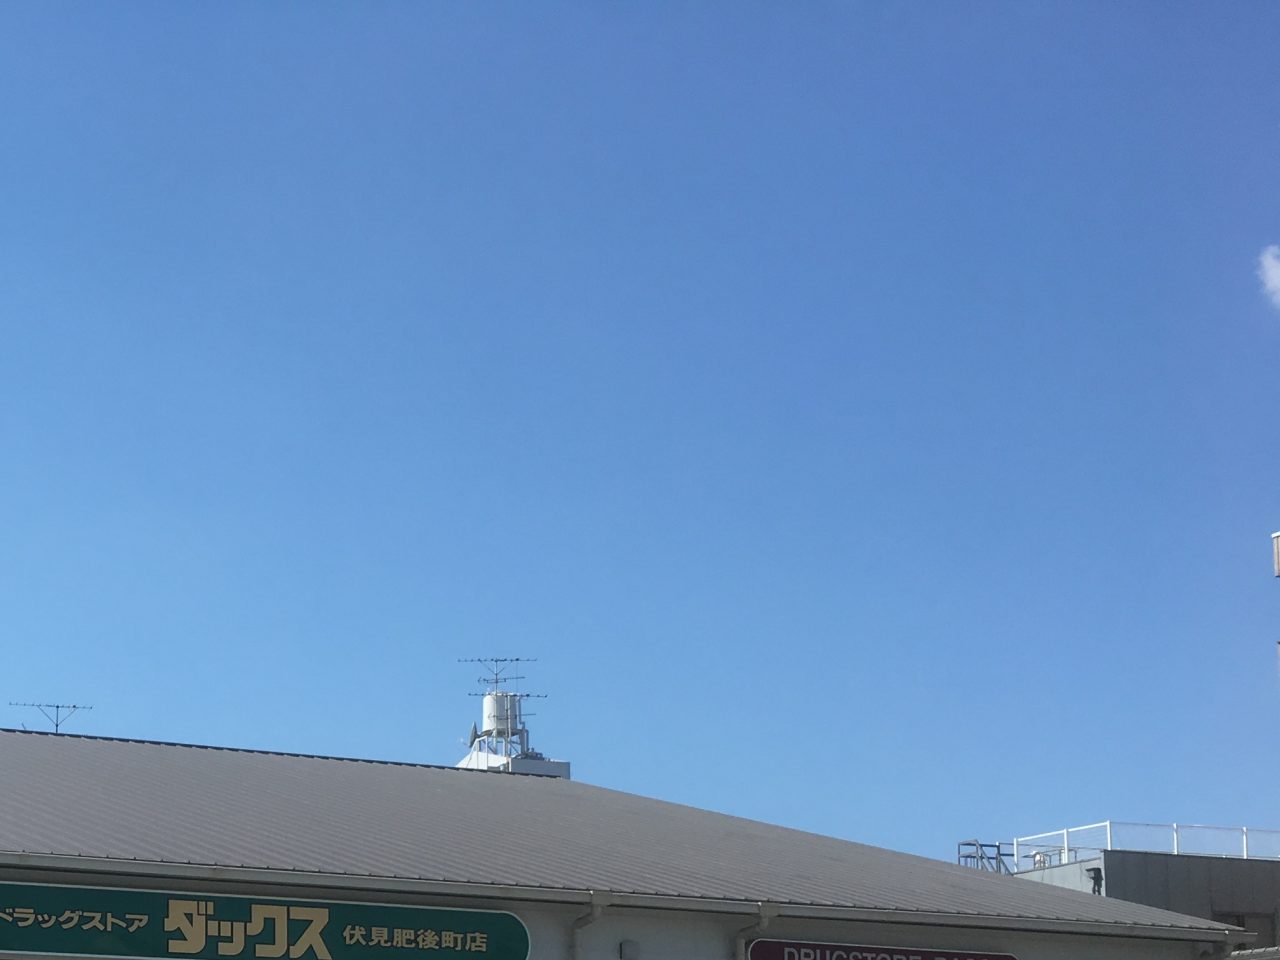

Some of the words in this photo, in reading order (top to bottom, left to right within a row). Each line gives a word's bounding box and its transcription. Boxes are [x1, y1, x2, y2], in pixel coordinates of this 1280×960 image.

[164, 899, 333, 960] ダックス
[343, 925, 489, 953] 伏見肥後町店
